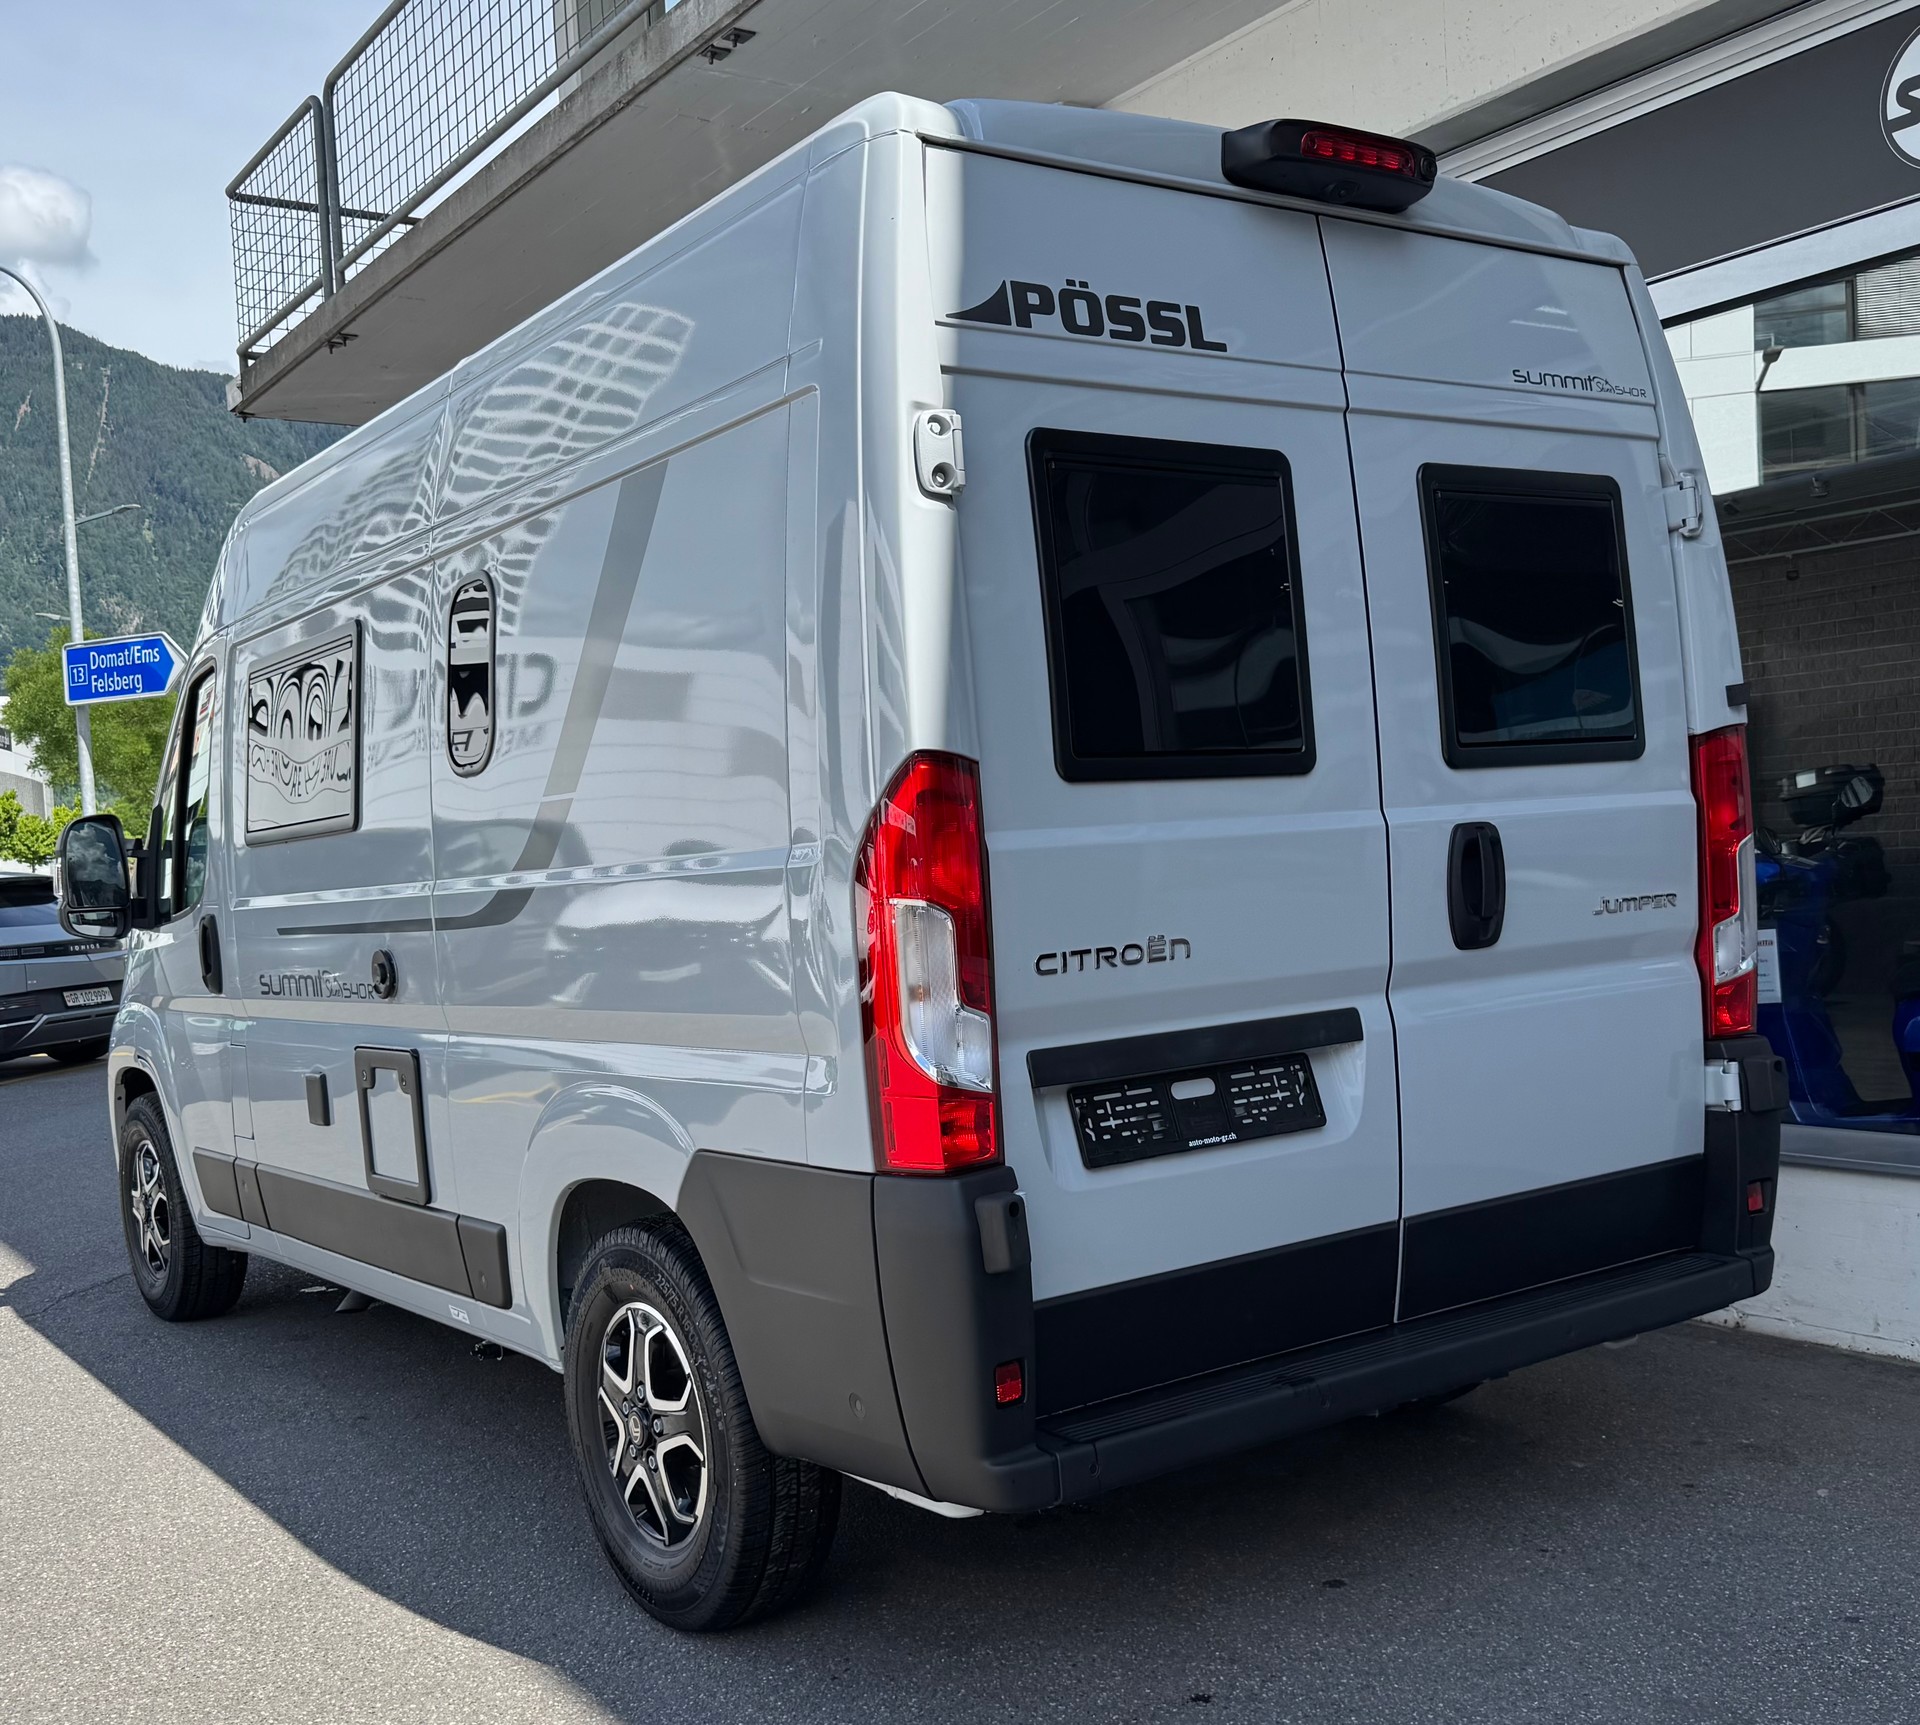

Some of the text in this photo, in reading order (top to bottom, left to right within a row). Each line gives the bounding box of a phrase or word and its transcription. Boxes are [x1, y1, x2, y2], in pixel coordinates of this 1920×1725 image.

[1009, 278, 1228, 352] PÖSSL
[90, 645, 160, 670] Domat/Ems
[72, 667, 85, 682] 13
[91, 672, 143, 693] Felsberg
[1592, 892, 1677, 915] JUMPER
[1188, 1132, 1237, 1147] auto-moto-gr.ch
